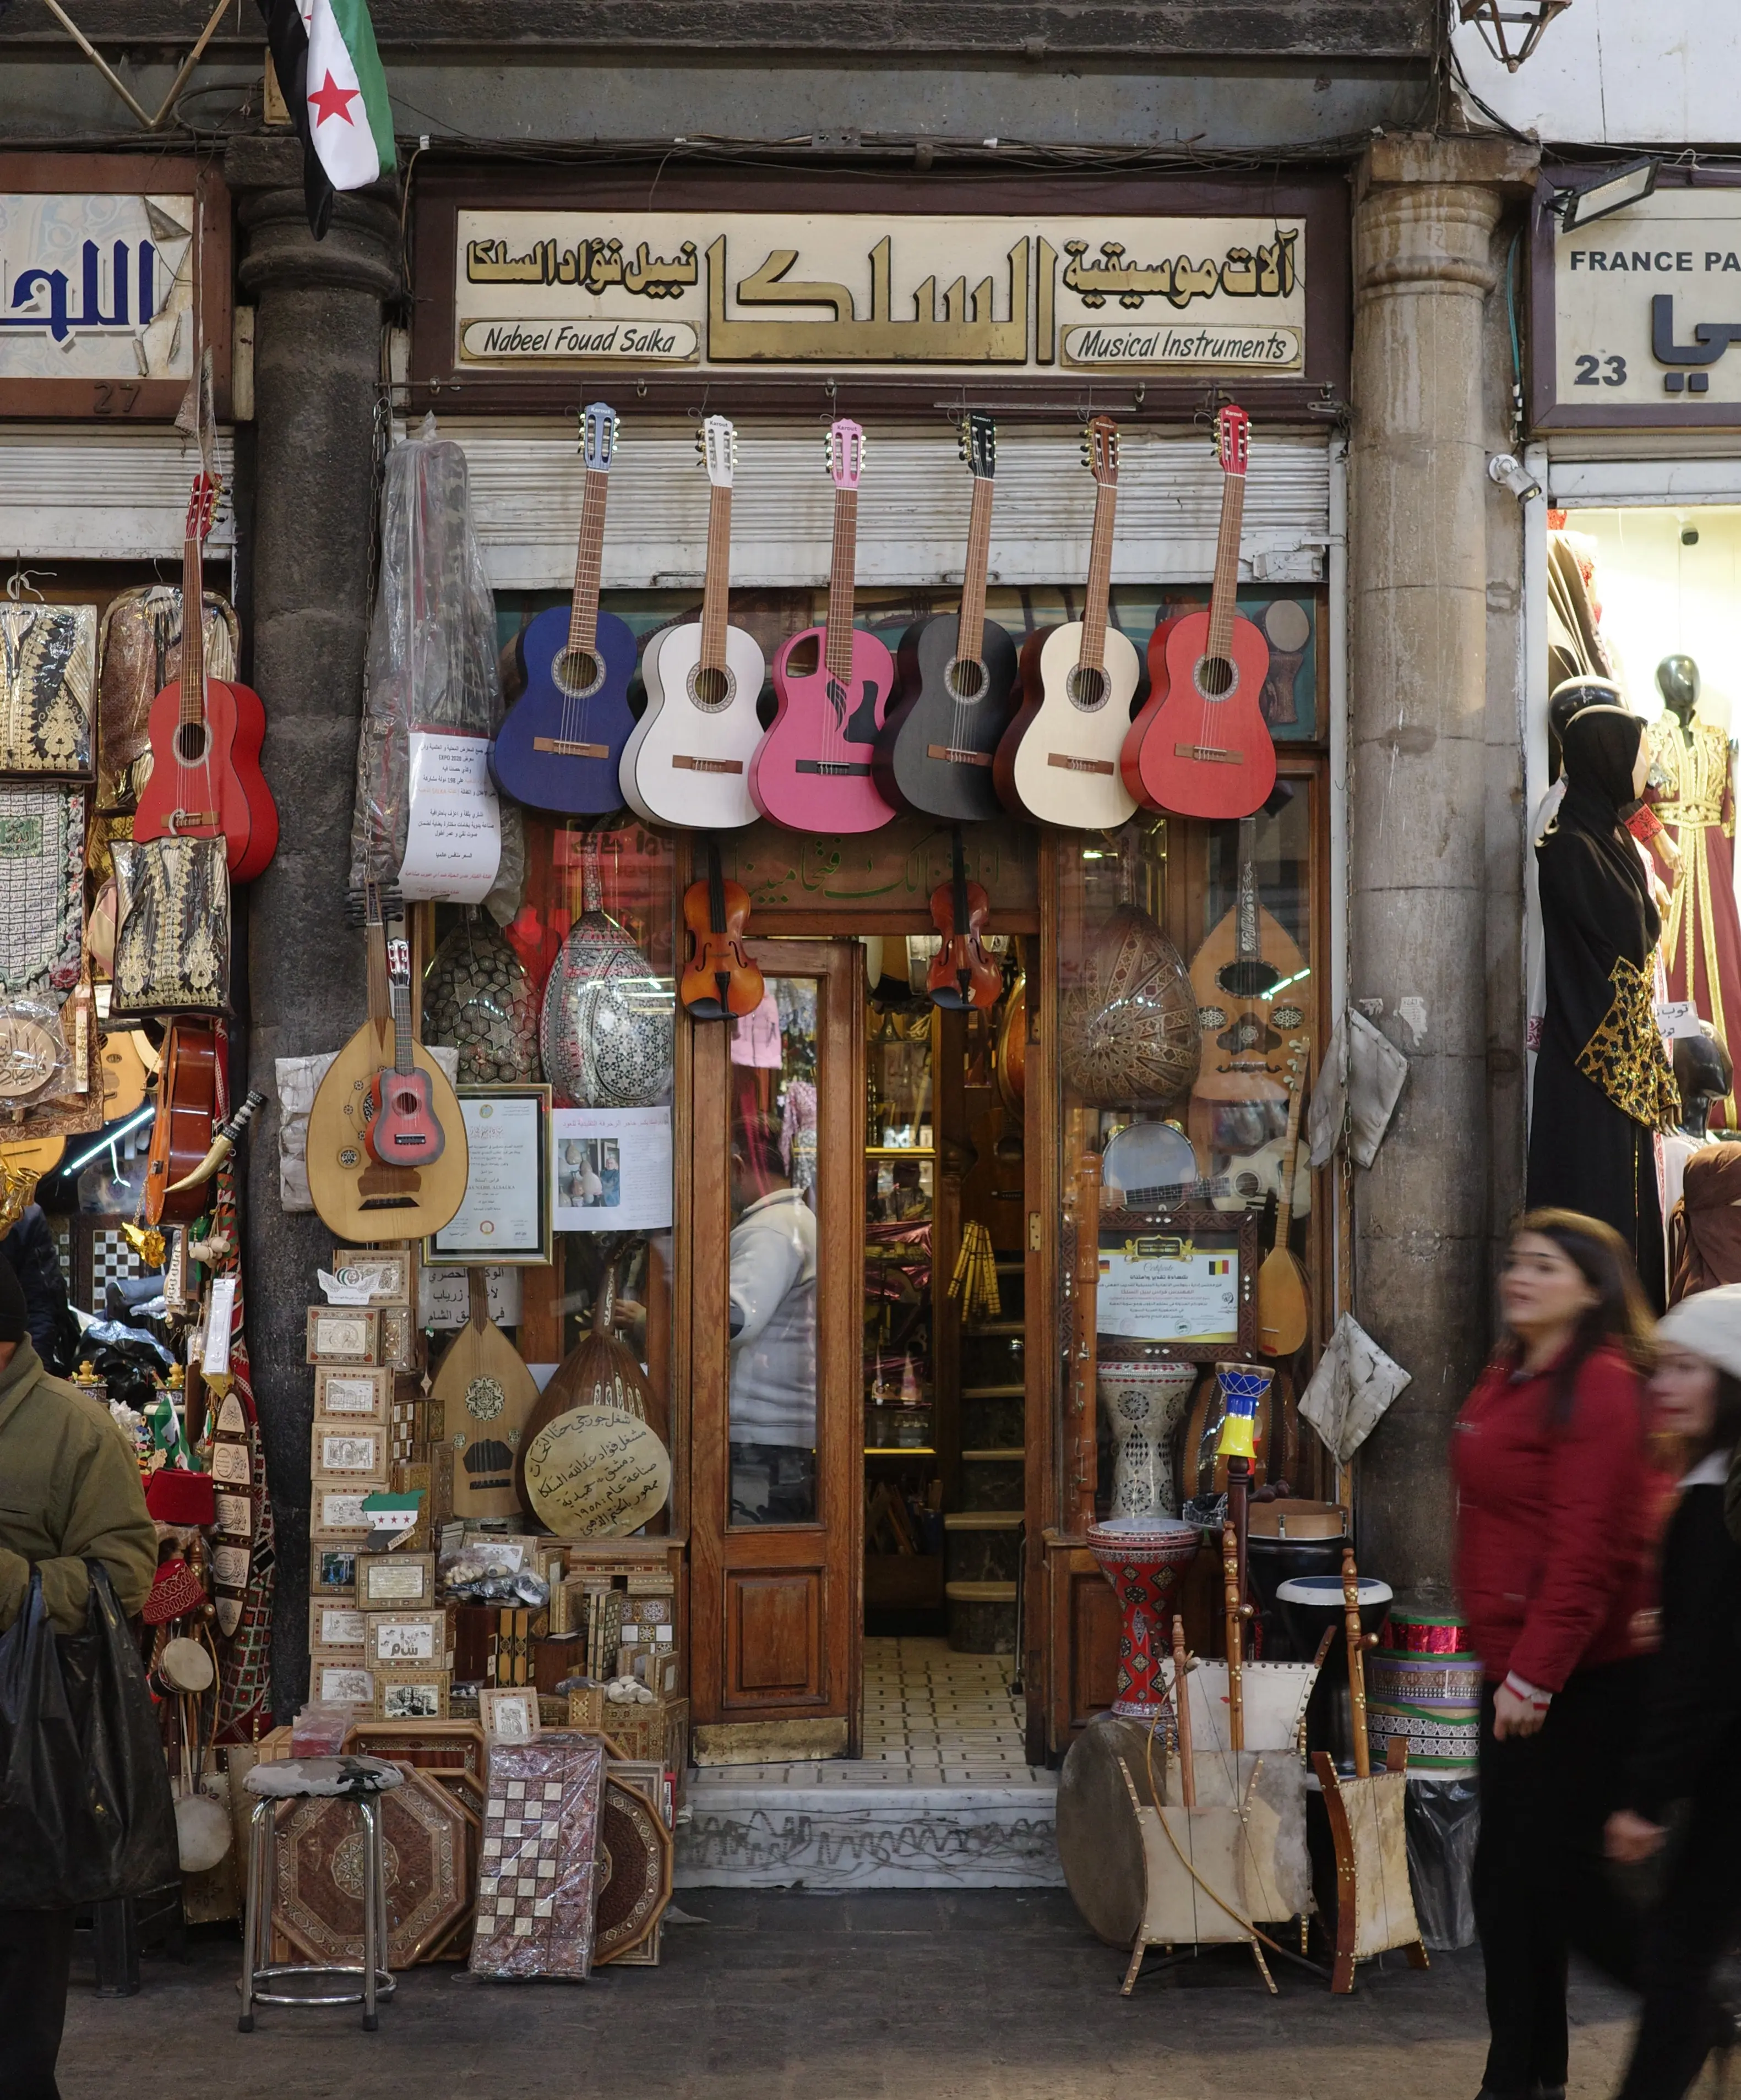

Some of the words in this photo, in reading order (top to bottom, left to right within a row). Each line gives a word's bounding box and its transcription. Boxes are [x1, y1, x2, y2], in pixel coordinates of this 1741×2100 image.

[466, 238, 557, 285] السلكا
[557, 237, 624, 296] فؤاد
[623, 239, 699, 299] نبيل
[1221, 228, 1299, 298] آلات
[1570, 251, 1693, 272] FRANCE
[1705, 252, 1741, 272] PA
[1062, 240, 1220, 309] موسيقية
[705, 233, 1058, 366] السلكا
[483, 326, 549, 353] Nabeel
[555, 325, 619, 353] Fouad
[620, 328, 676, 354] Salka
[1077, 330, 1161, 359] Musical
[1161, 330, 1287, 360] Instruments
[1574, 354, 1628, 386] 23
[94, 381, 140, 414] 27
[710, 420, 728, 428] Karout
[1225, 410, 1243, 418] Karout
[1662, 1004, 1689, 1019] توب
[485, 1267, 504, 1280] الوك
[433, 1289, 463, 1302] زرياب
[427, 1310, 452, 1325] الشام
[605, 1412, 631, 1427] شغل
[597, 1441, 619, 1460] فؤاد
[618, 1430, 647, 1452] مشغل
[604, 1455, 635, 1482] دمشق
[623, 1462, 657, 1484] صناعة
[573, 1501, 602, 1519] ١٩٥٨
